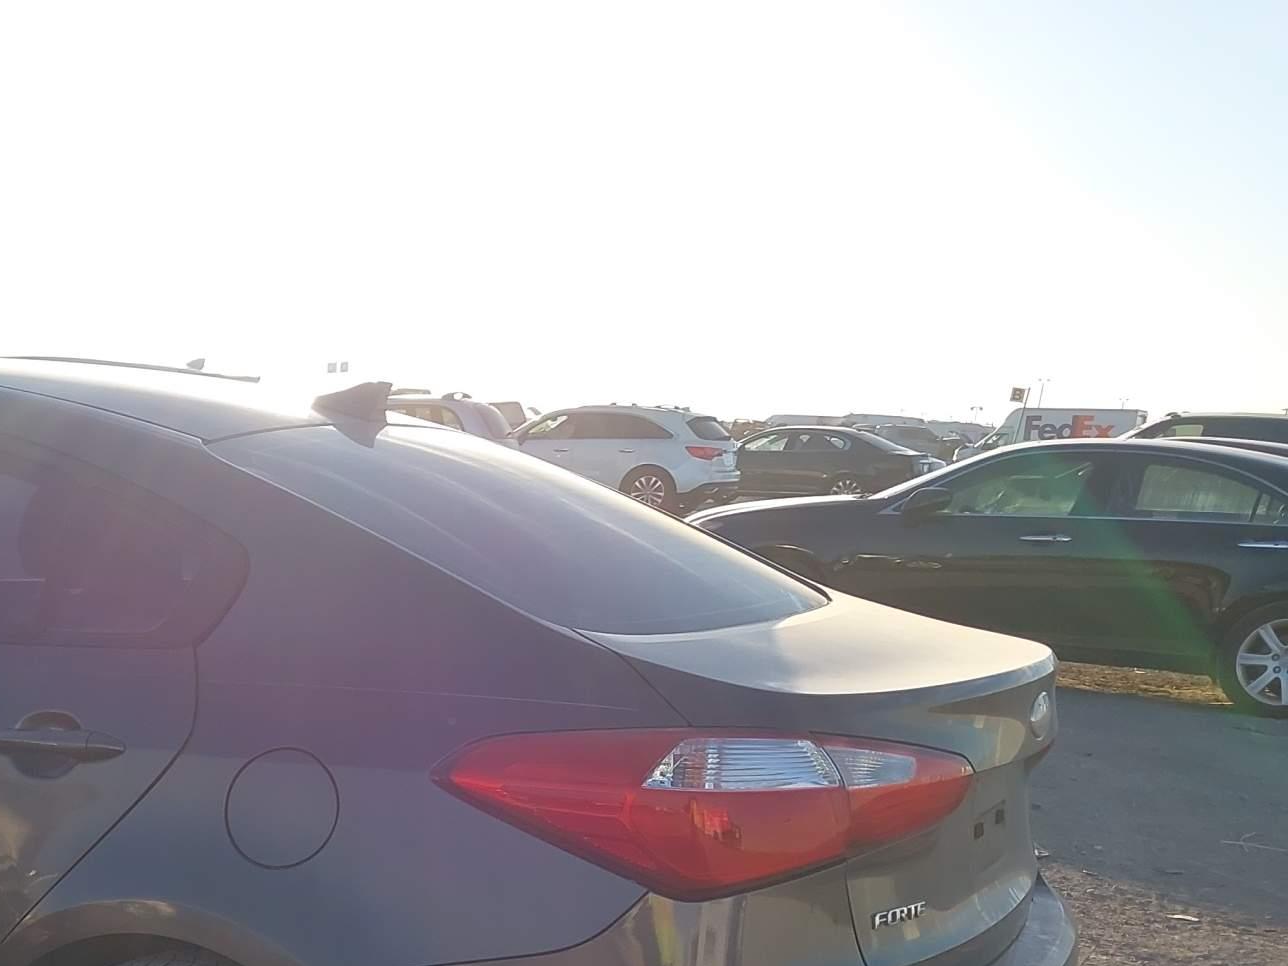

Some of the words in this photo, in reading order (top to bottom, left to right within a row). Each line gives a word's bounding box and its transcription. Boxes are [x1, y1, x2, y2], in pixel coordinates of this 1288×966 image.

[1012, 388, 1023, 401] B
[1024, 415, 1114, 440] FedEx
[872, 900, 926, 930] FORTE
